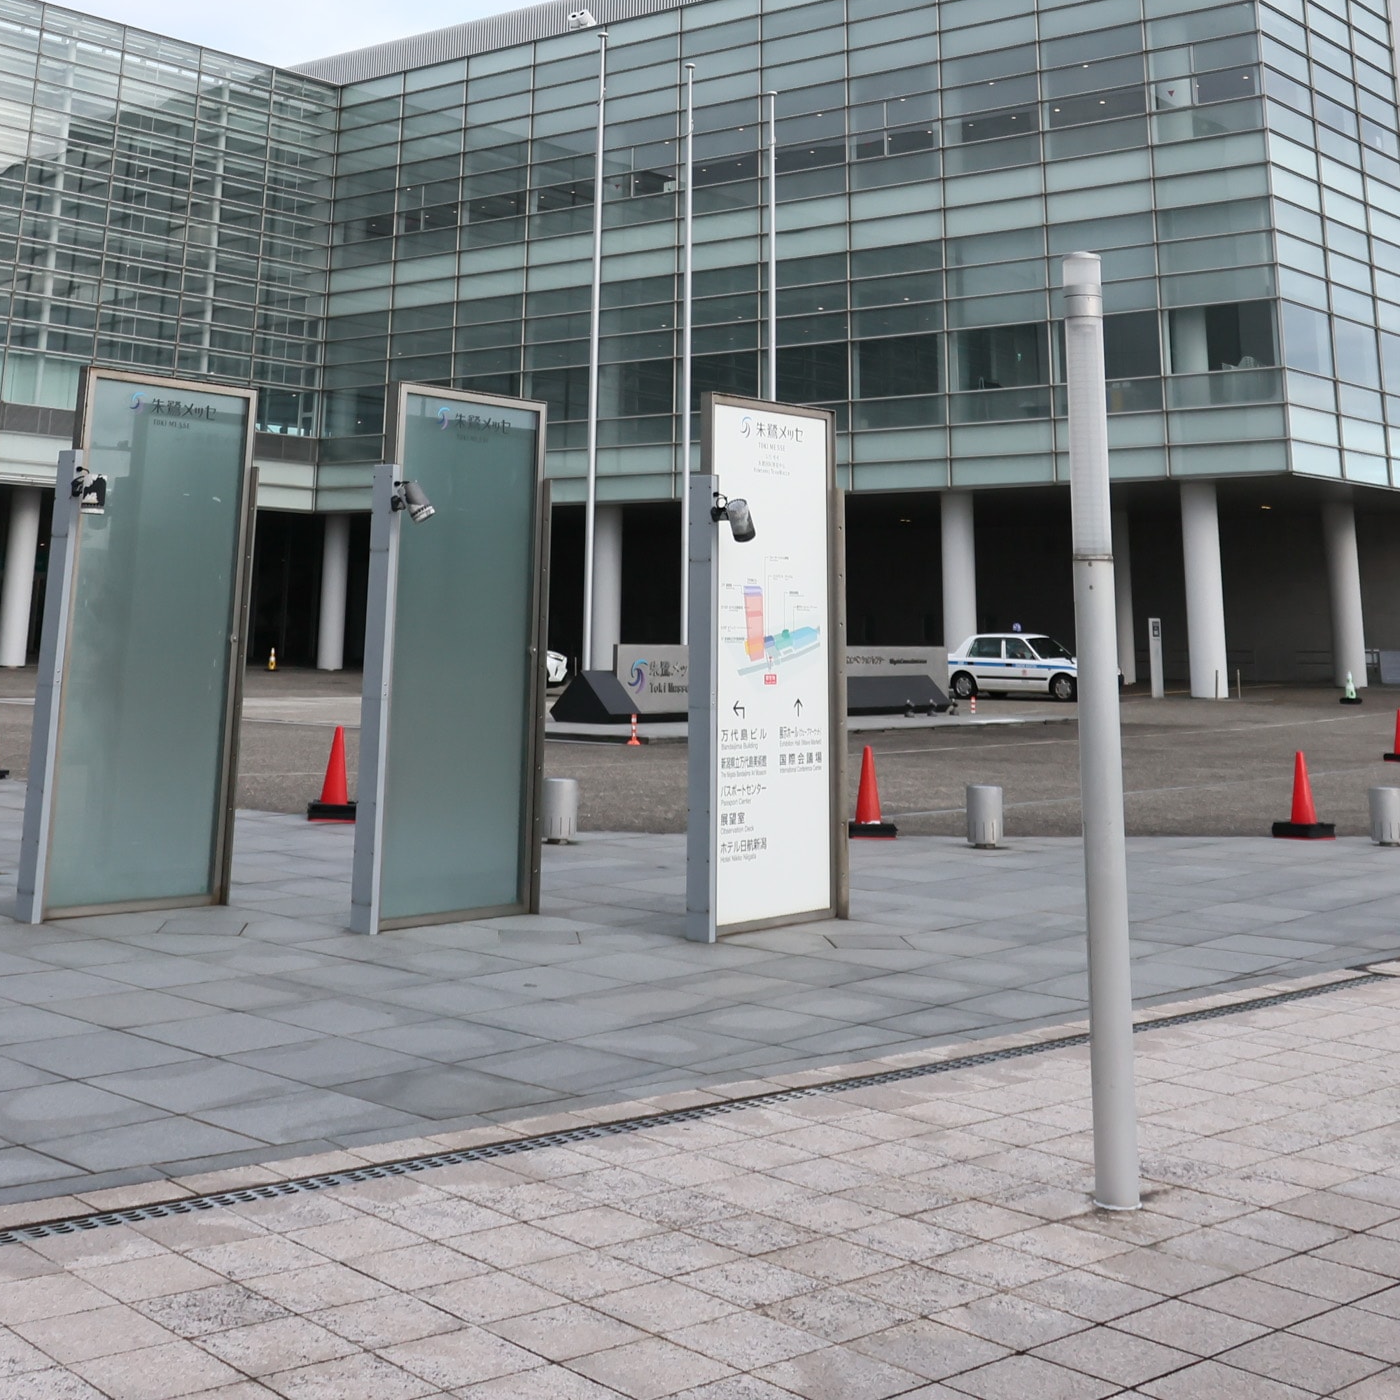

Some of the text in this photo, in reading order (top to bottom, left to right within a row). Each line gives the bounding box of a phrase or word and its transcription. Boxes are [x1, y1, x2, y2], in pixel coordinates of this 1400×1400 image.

[151, 398, 217, 421] 朱鷺メッセ
[455, 412, 511, 435] 朱鷺メッセ
[756, 421, 803, 442] 朱鷺メッセ
[649, 660, 688, 677] 朱鷺メッ
[720, 728, 767, 742] 万代島ビル
[779, 751, 822, 765] 国際会議場
[720, 784, 767, 798] パスポートセンター
[720, 812, 745, 826] 展望室
[720, 837, 767, 854] ホテル日航新潟
